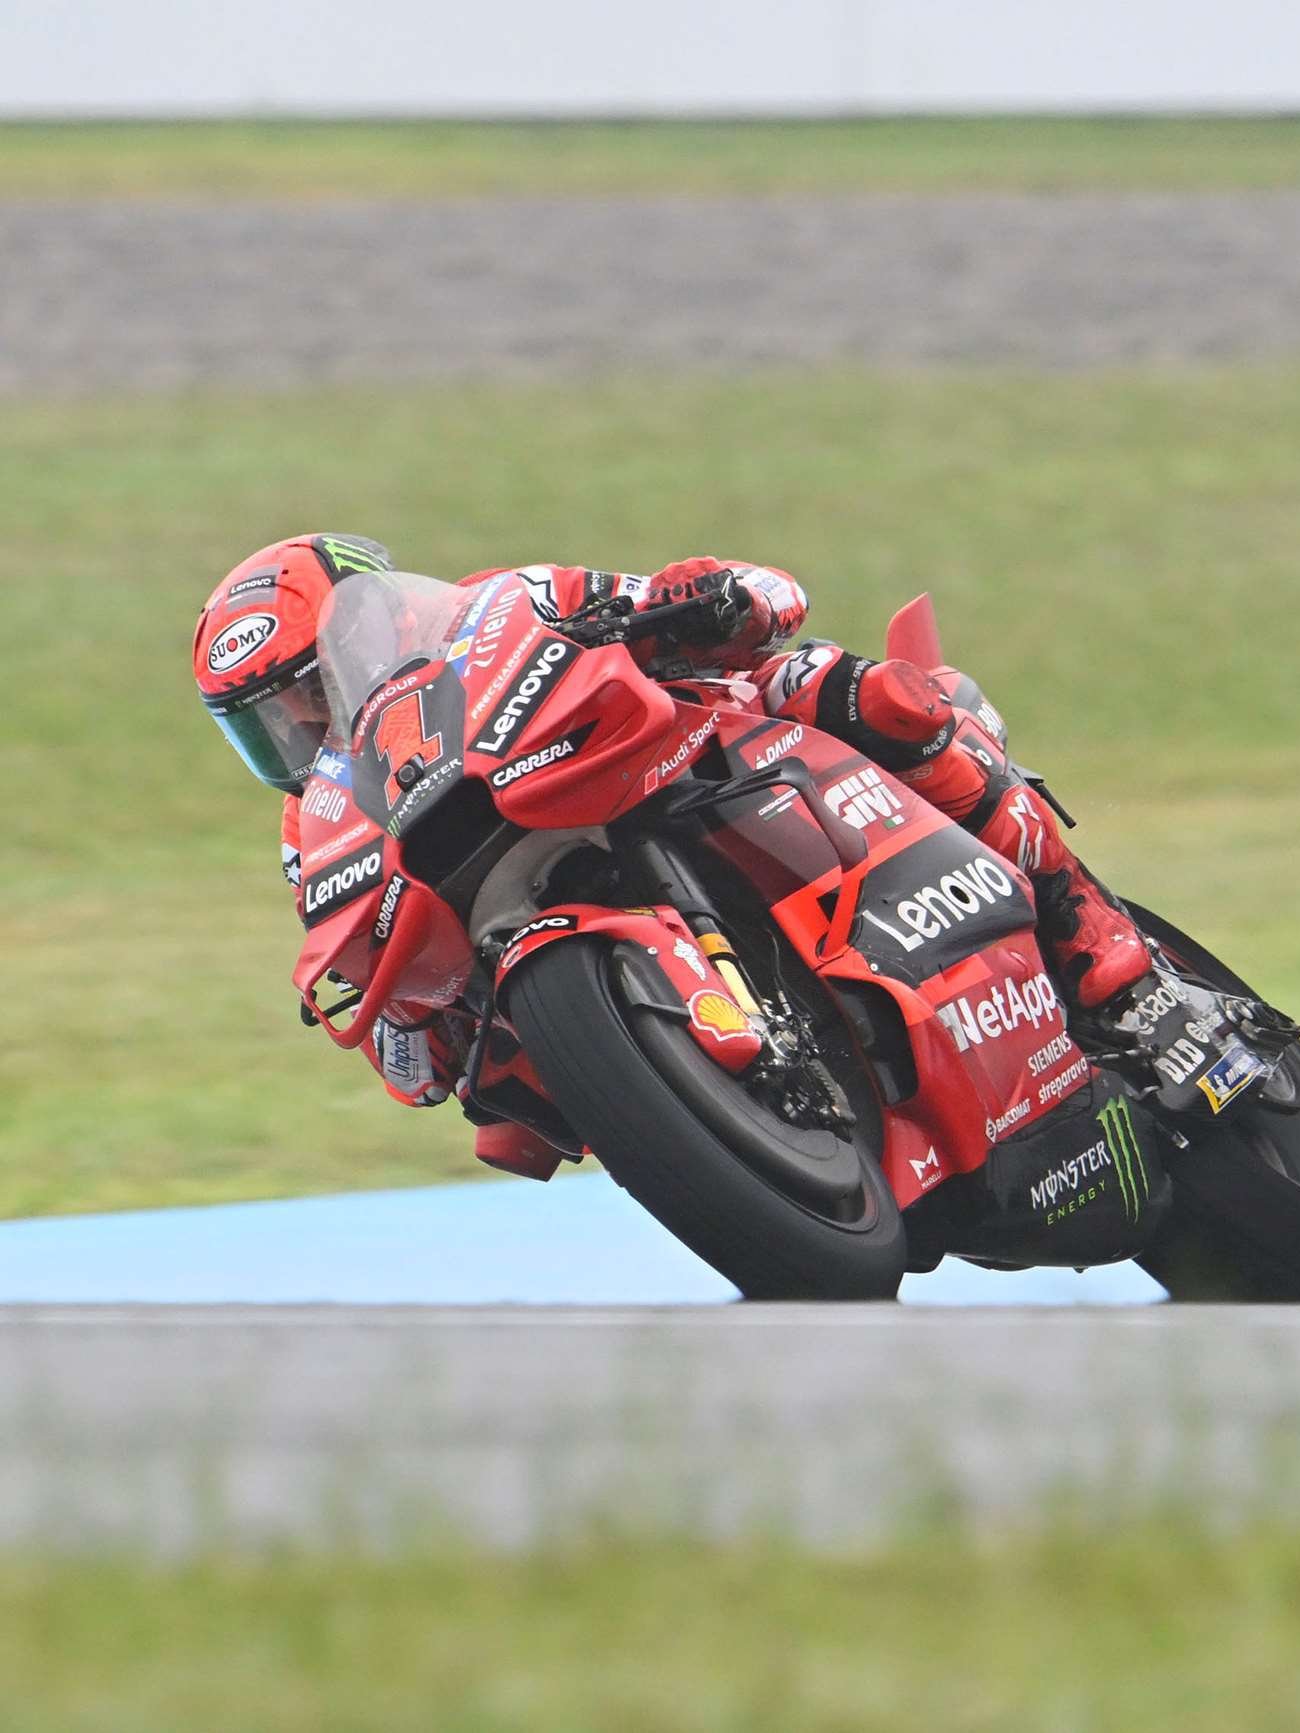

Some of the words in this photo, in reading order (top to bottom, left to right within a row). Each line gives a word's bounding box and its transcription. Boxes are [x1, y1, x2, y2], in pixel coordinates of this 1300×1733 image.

[230, 578, 272, 594] Lenovo
[210, 624, 268, 663] SUOMY
[477, 642, 567, 753] Lenovo
[492, 740, 574, 786] CARRERA
[660, 744, 689, 777] Audi
[688, 711, 721, 750] Sport
[305, 852, 381, 913] Lenovo
[376, 876, 403, 938] CARRERA
[862, 857, 1013, 953] Lenovo
[946, 973, 1056, 1050] NetApp
[1028, 1031, 1072, 1077] SIEMENS
[1038, 1056, 1088, 1104] streparava
[1030, 1141, 1111, 1210] MONSTER
[1048, 1180, 1106, 1225] ENERGY
